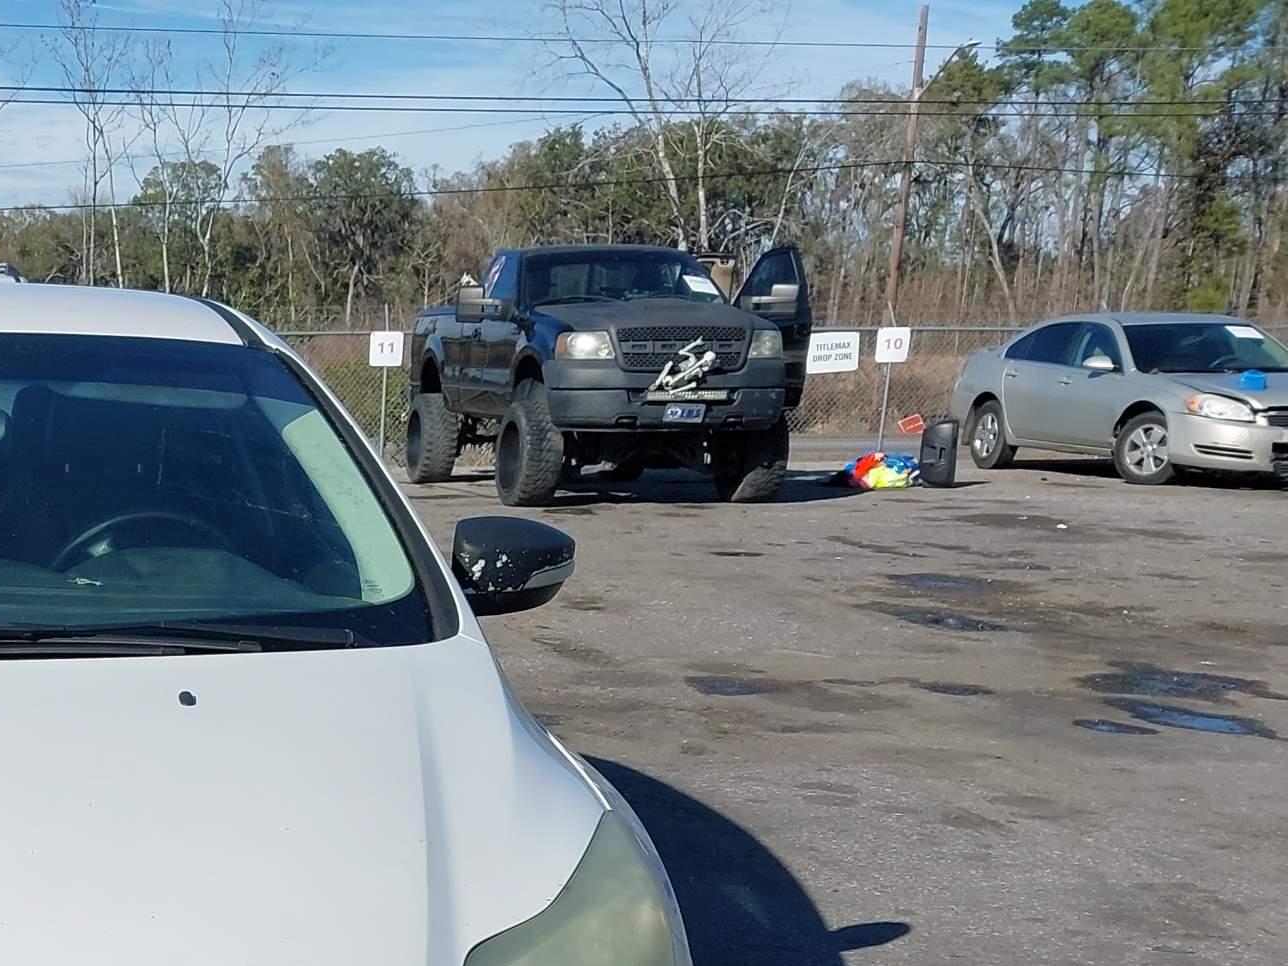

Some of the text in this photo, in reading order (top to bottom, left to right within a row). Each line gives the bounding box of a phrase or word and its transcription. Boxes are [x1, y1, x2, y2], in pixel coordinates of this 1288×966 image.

[378, 342, 394, 354] 11
[815, 342, 852, 351] TITLEMAX
[885, 338, 903, 350] 10
[812, 352, 853, 363] DROP ZONE
